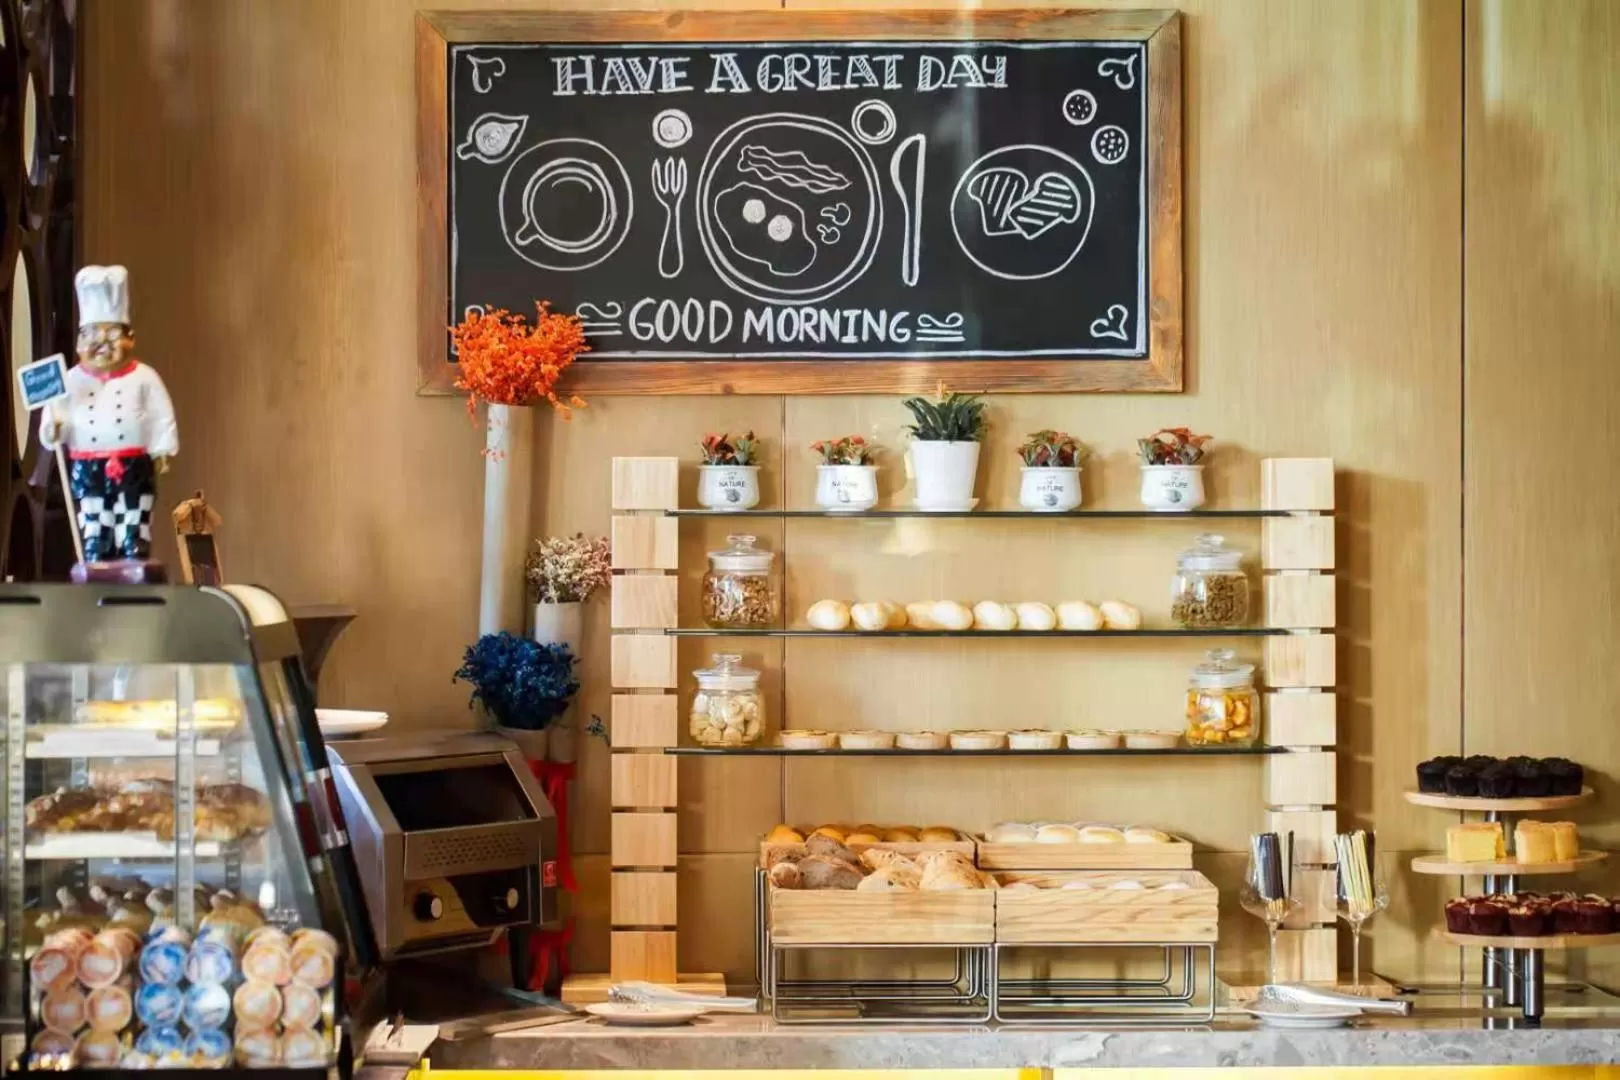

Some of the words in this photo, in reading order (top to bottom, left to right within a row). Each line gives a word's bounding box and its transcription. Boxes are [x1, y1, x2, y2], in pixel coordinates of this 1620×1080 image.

[550, 54, 695, 96] HAVE
[704, 52, 752, 93] A
[756, 53, 905, 94] GREAT
[916, 54, 1009, 93] DAY
[628, 297, 734, 343] GOOD
[742, 306, 912, 344] MORNING
[718, 480, 746, 488] NATURE
